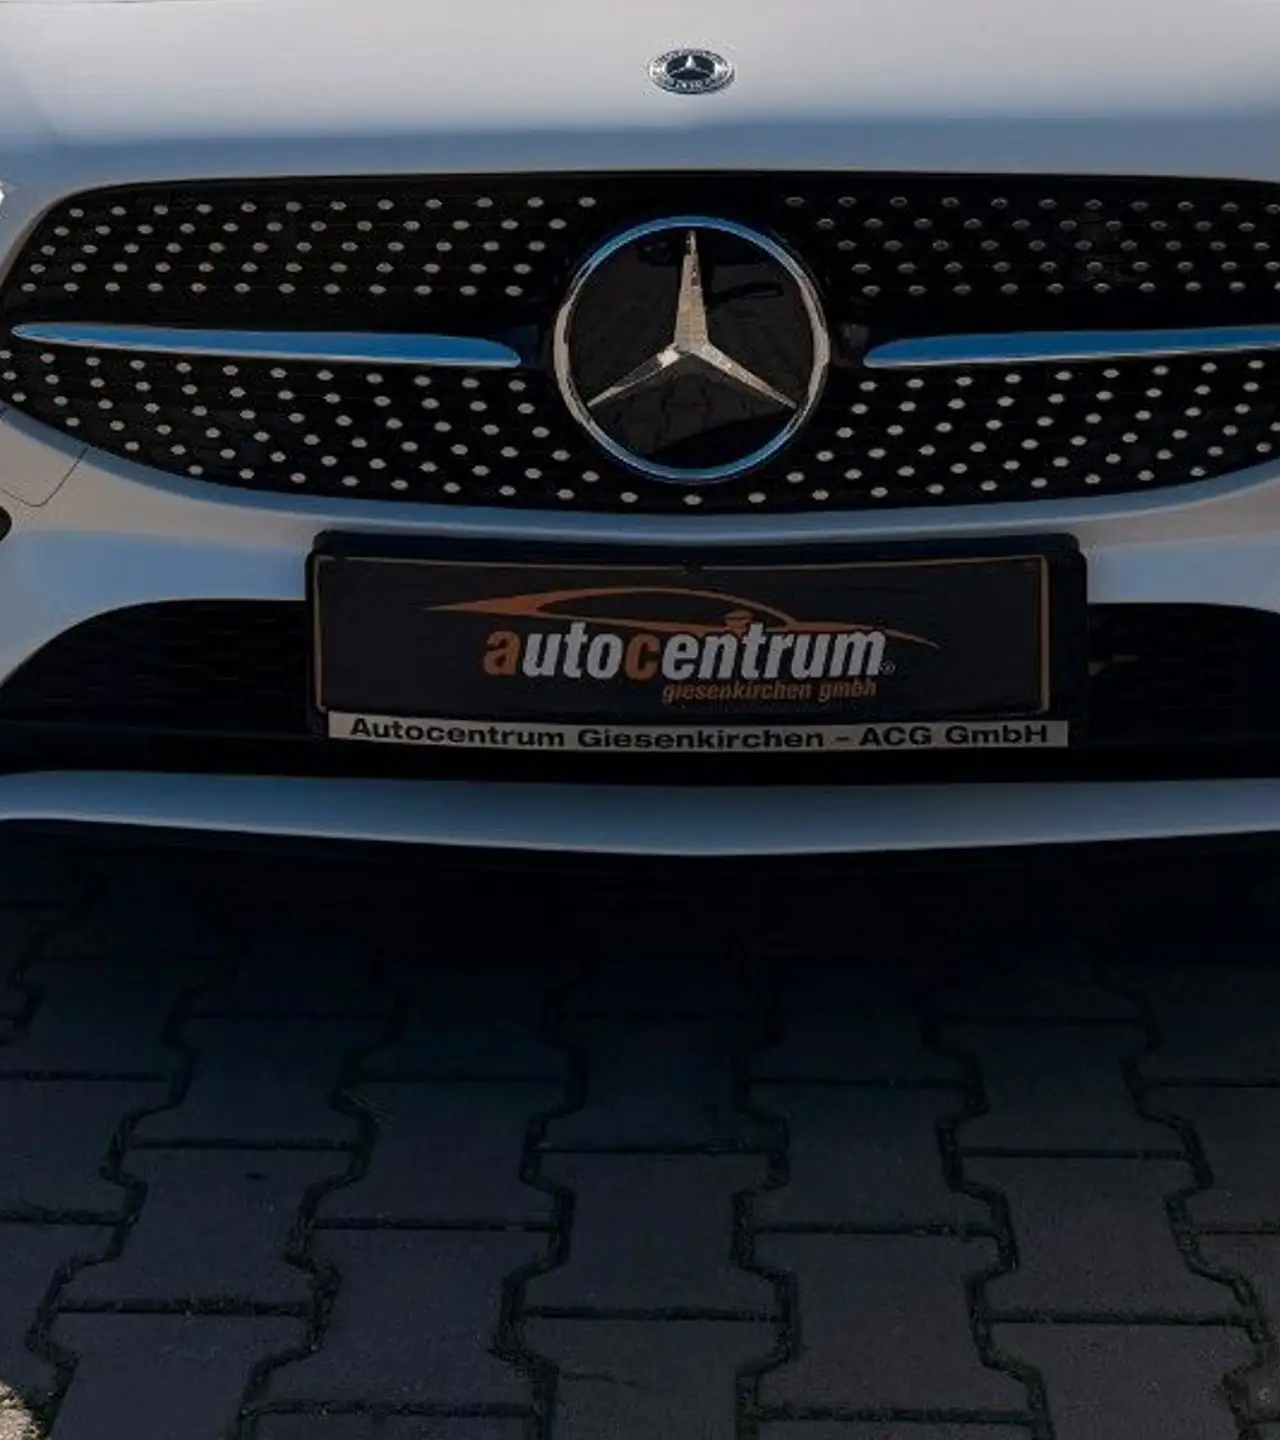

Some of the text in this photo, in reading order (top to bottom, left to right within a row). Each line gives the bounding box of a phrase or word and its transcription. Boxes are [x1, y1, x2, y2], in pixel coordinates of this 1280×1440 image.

[483, 621, 887, 680] autocentrum
[662, 679, 877, 703] giesenkirchen gmbh
[350, 716, 566, 748] Autocentrum
[577, 727, 824, 750] Giesenkirchen
[858, 725, 932, 747] ACG
[945, 724, 1048, 745] GmbH
